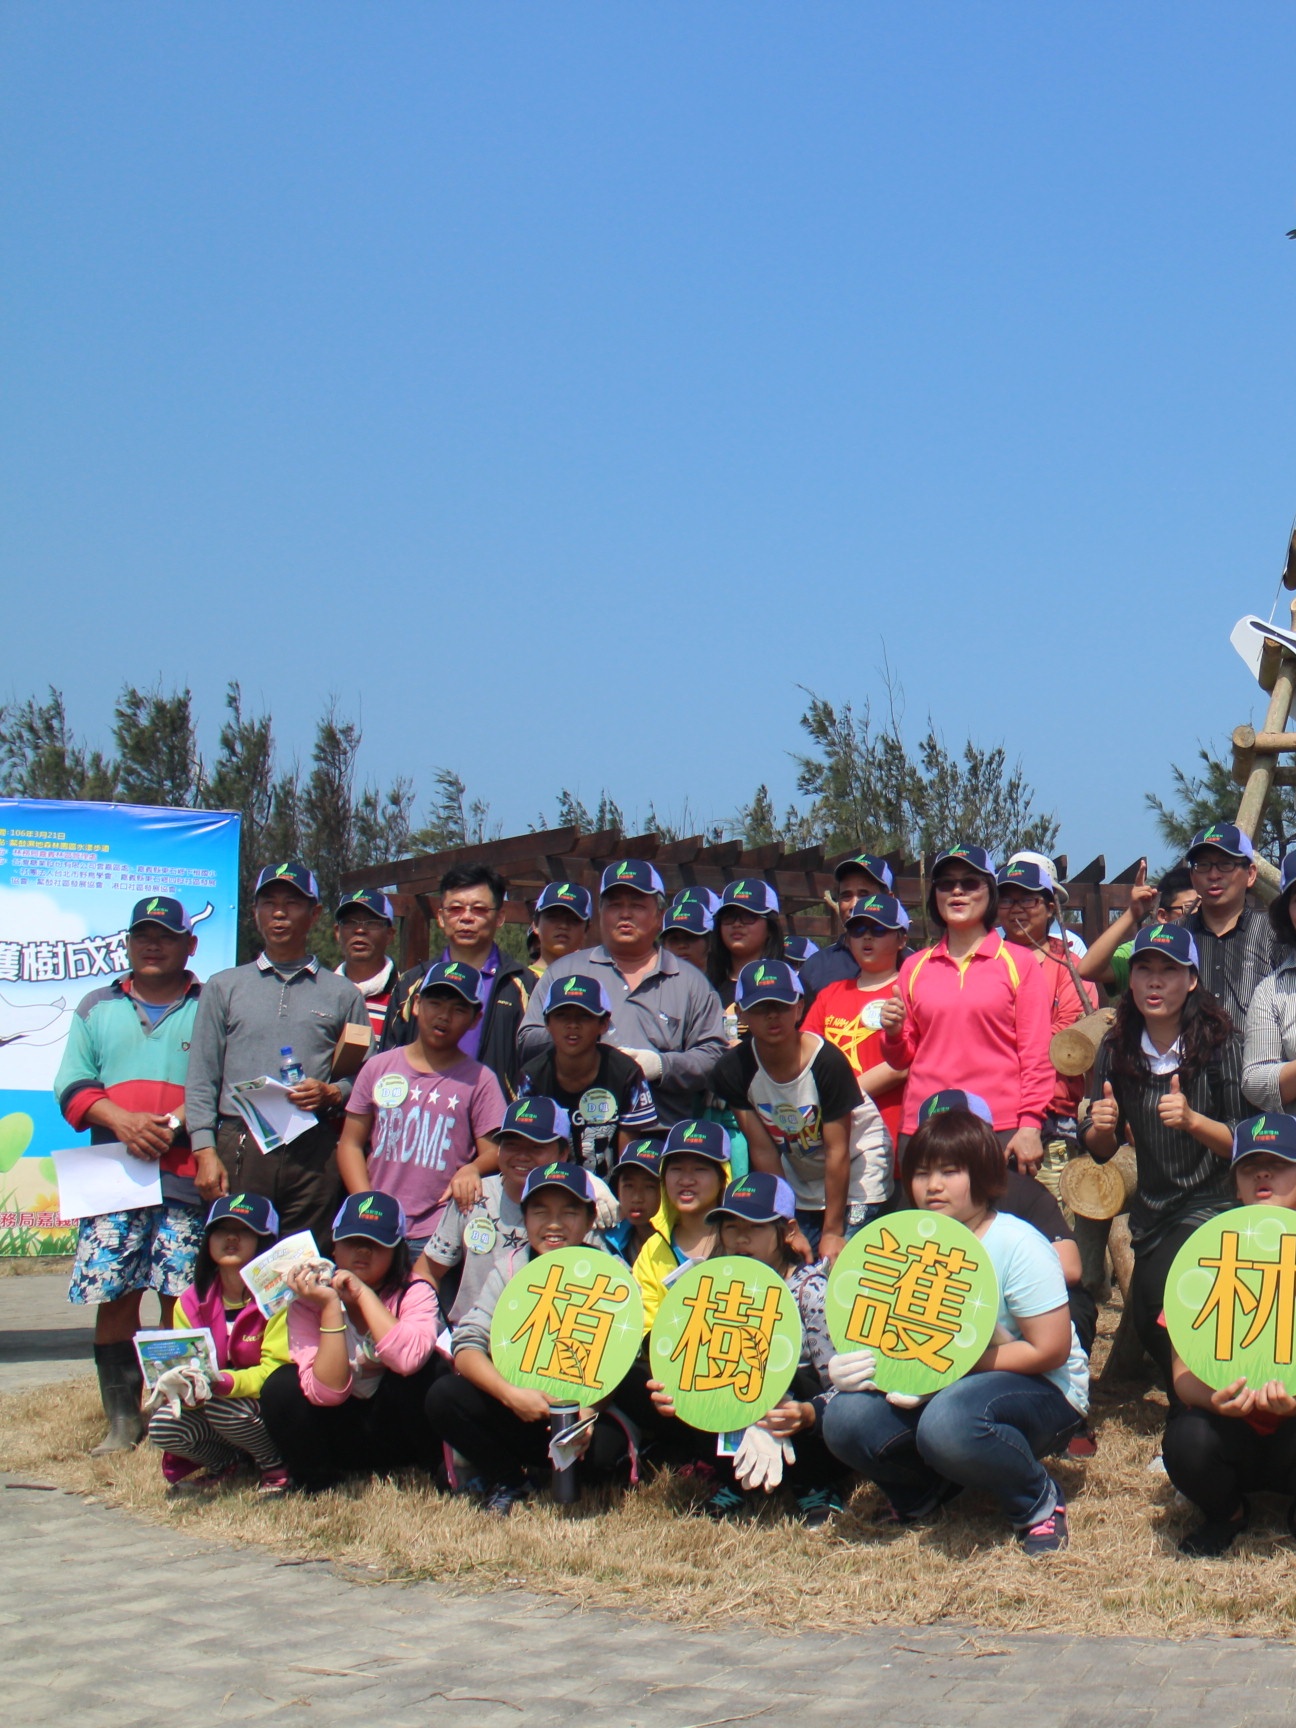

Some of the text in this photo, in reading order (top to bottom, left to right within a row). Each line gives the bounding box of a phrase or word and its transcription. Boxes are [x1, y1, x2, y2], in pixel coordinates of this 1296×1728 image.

[511, 1264, 630, 1390] 植
[670, 1275, 783, 1404] 樹
[845, 1229, 977, 1373] 護
